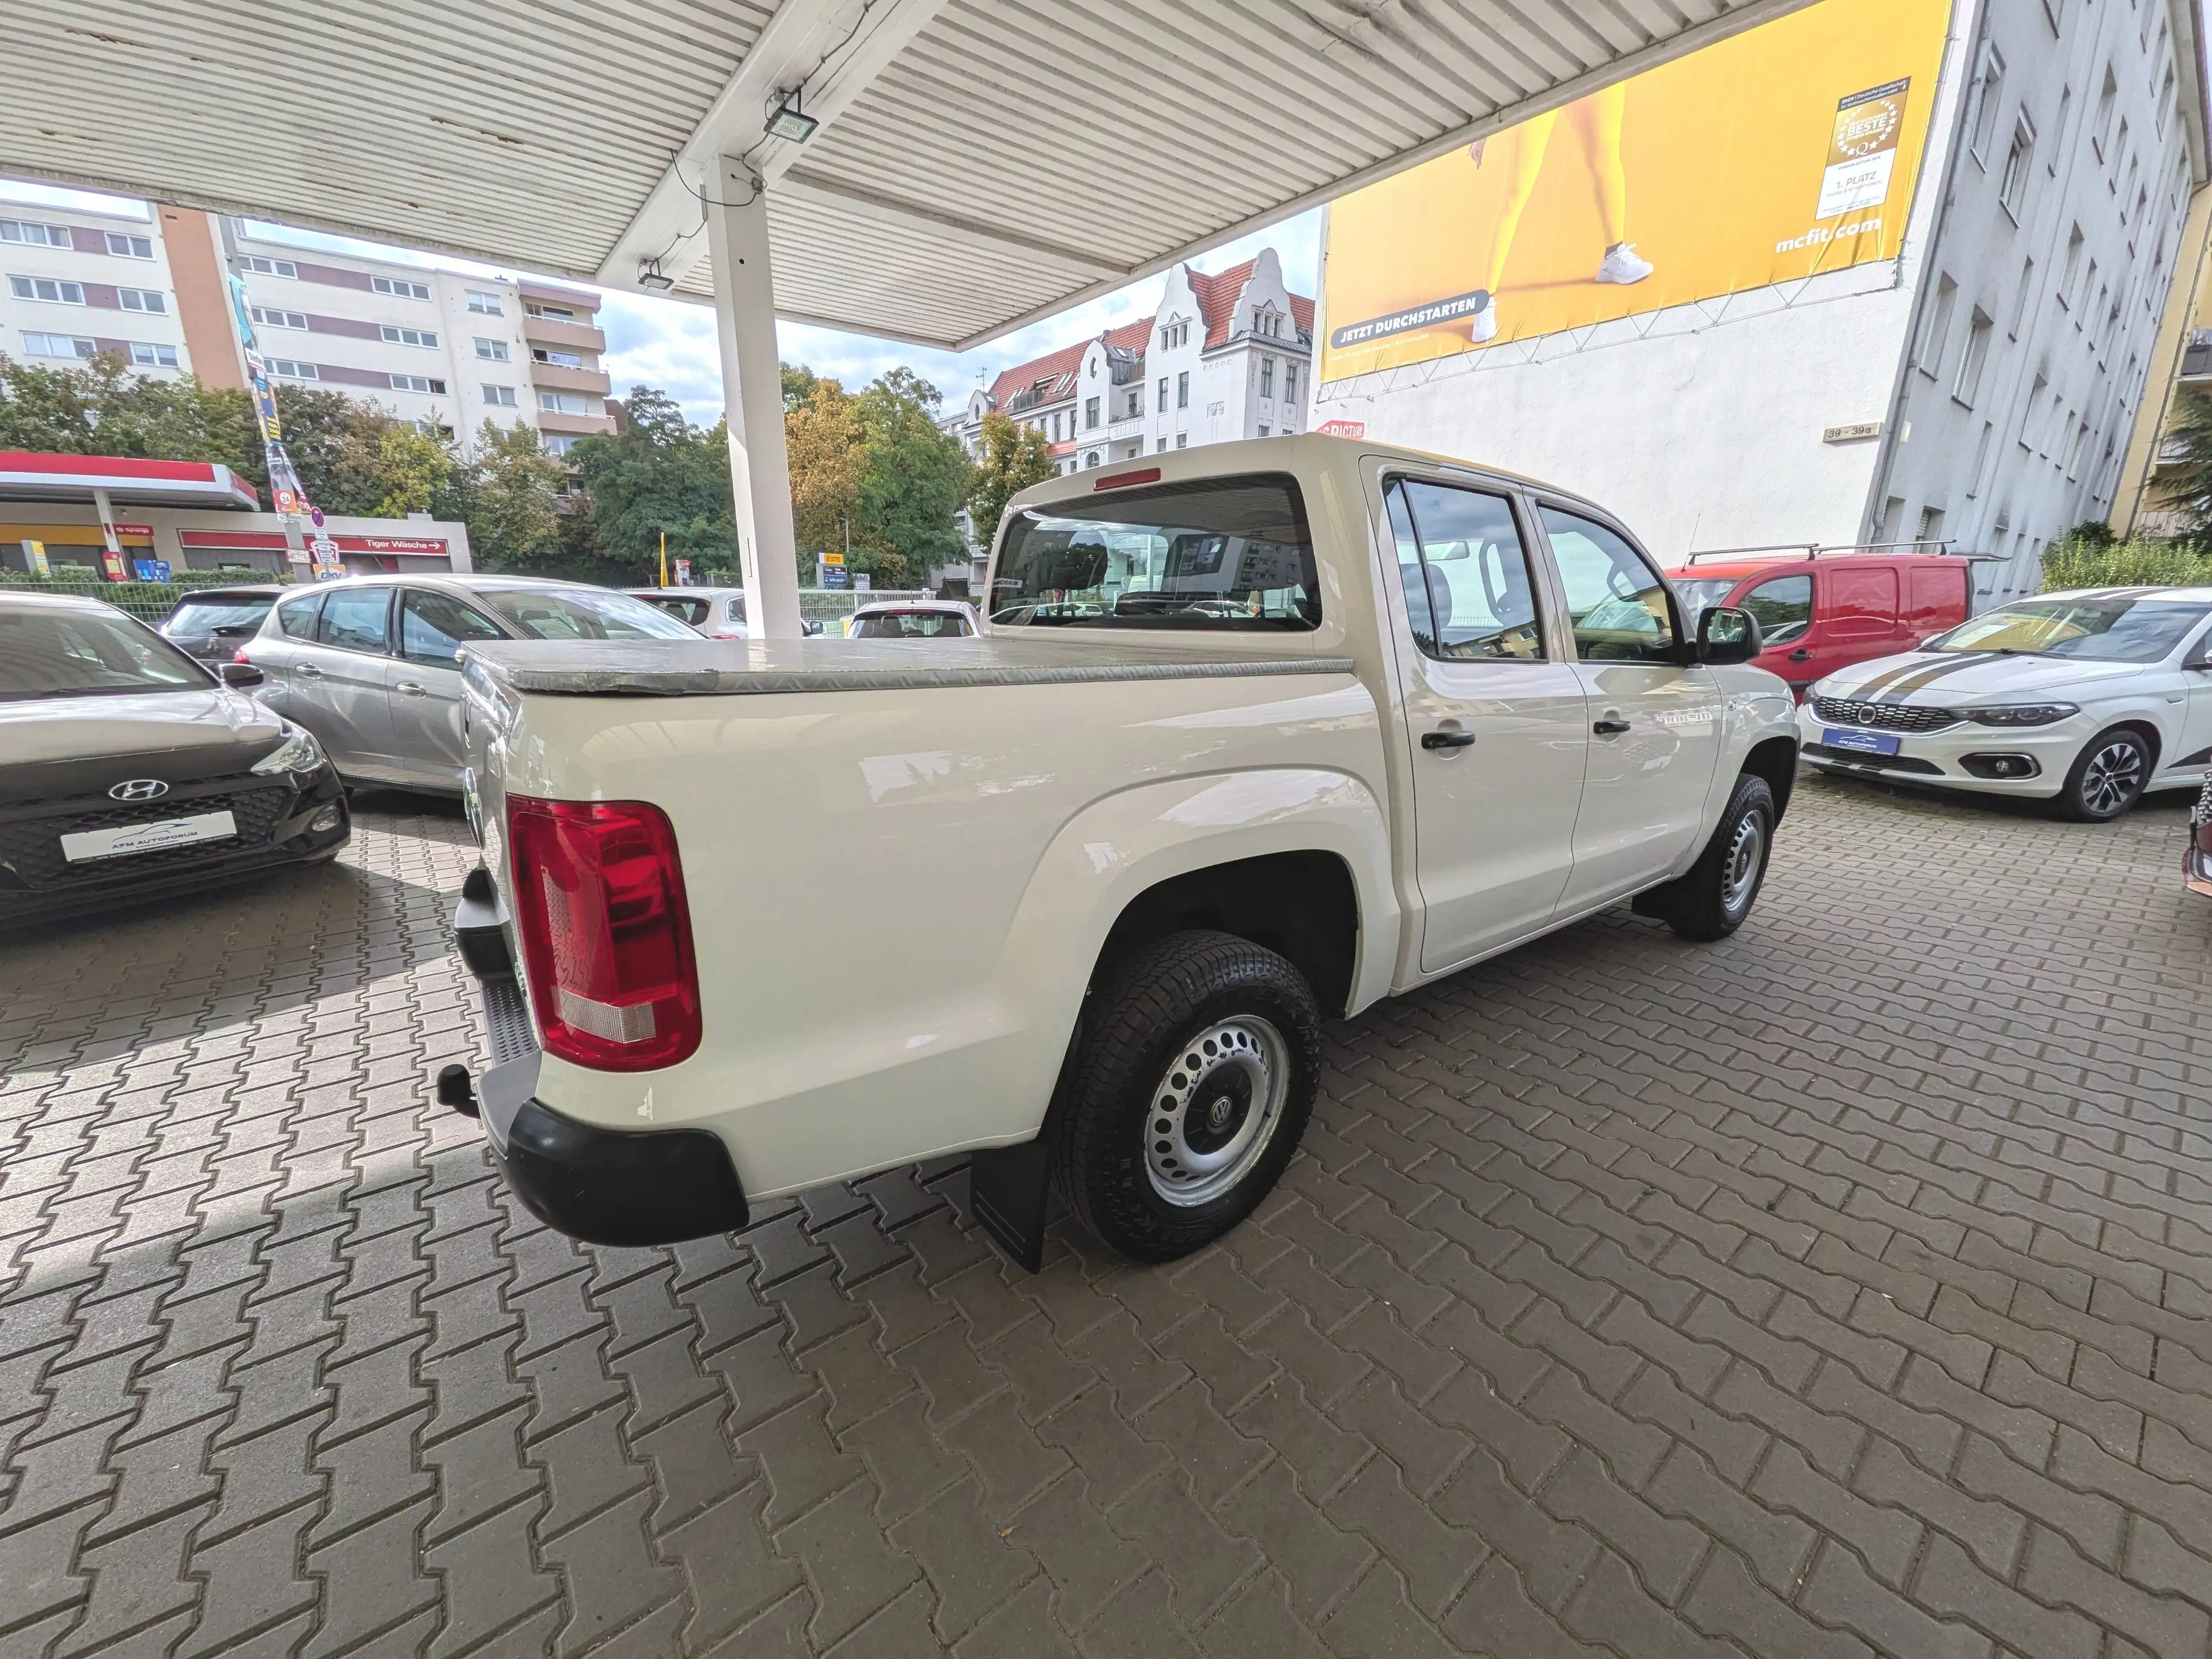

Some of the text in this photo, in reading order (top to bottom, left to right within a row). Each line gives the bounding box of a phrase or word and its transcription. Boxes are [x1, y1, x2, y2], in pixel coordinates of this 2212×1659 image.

[1878, 80, 1907, 92] Gesellschaft
[1847, 116, 1888, 137] BESTE
[1836, 171, 1877, 189] 1. PLATZ
[1775, 218, 1881, 253] mcfit.com
[1340, 297, 1476, 343] JETZT DURCHSTARTEN
[1331, 425, 1363, 437] PICTURE
[1828, 429, 1841, 438] 39
[1851, 426, 1872, 435] 39a
[365, 539, 427, 548] Tiger Wäsche
[138, 831, 198, 846] AUTOFORUM
